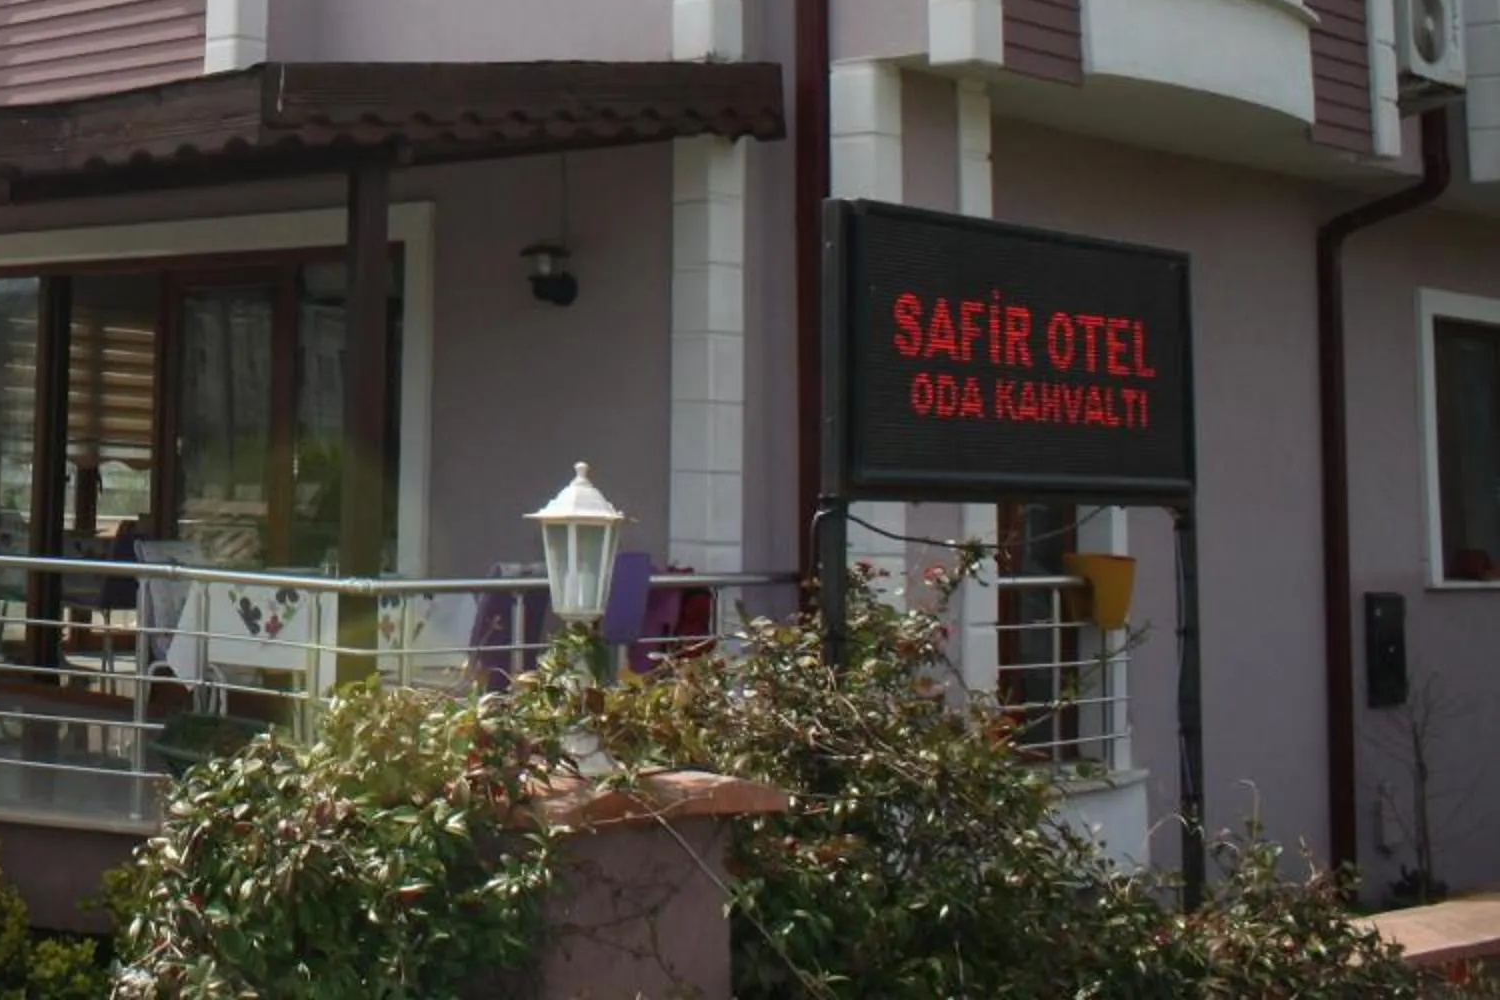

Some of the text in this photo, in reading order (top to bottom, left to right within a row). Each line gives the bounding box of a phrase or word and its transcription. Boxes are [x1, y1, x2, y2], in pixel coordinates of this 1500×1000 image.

[893, 289, 1156, 377] SAFİR OTEL
[911, 372, 1149, 428] ODA KAHVALTI
